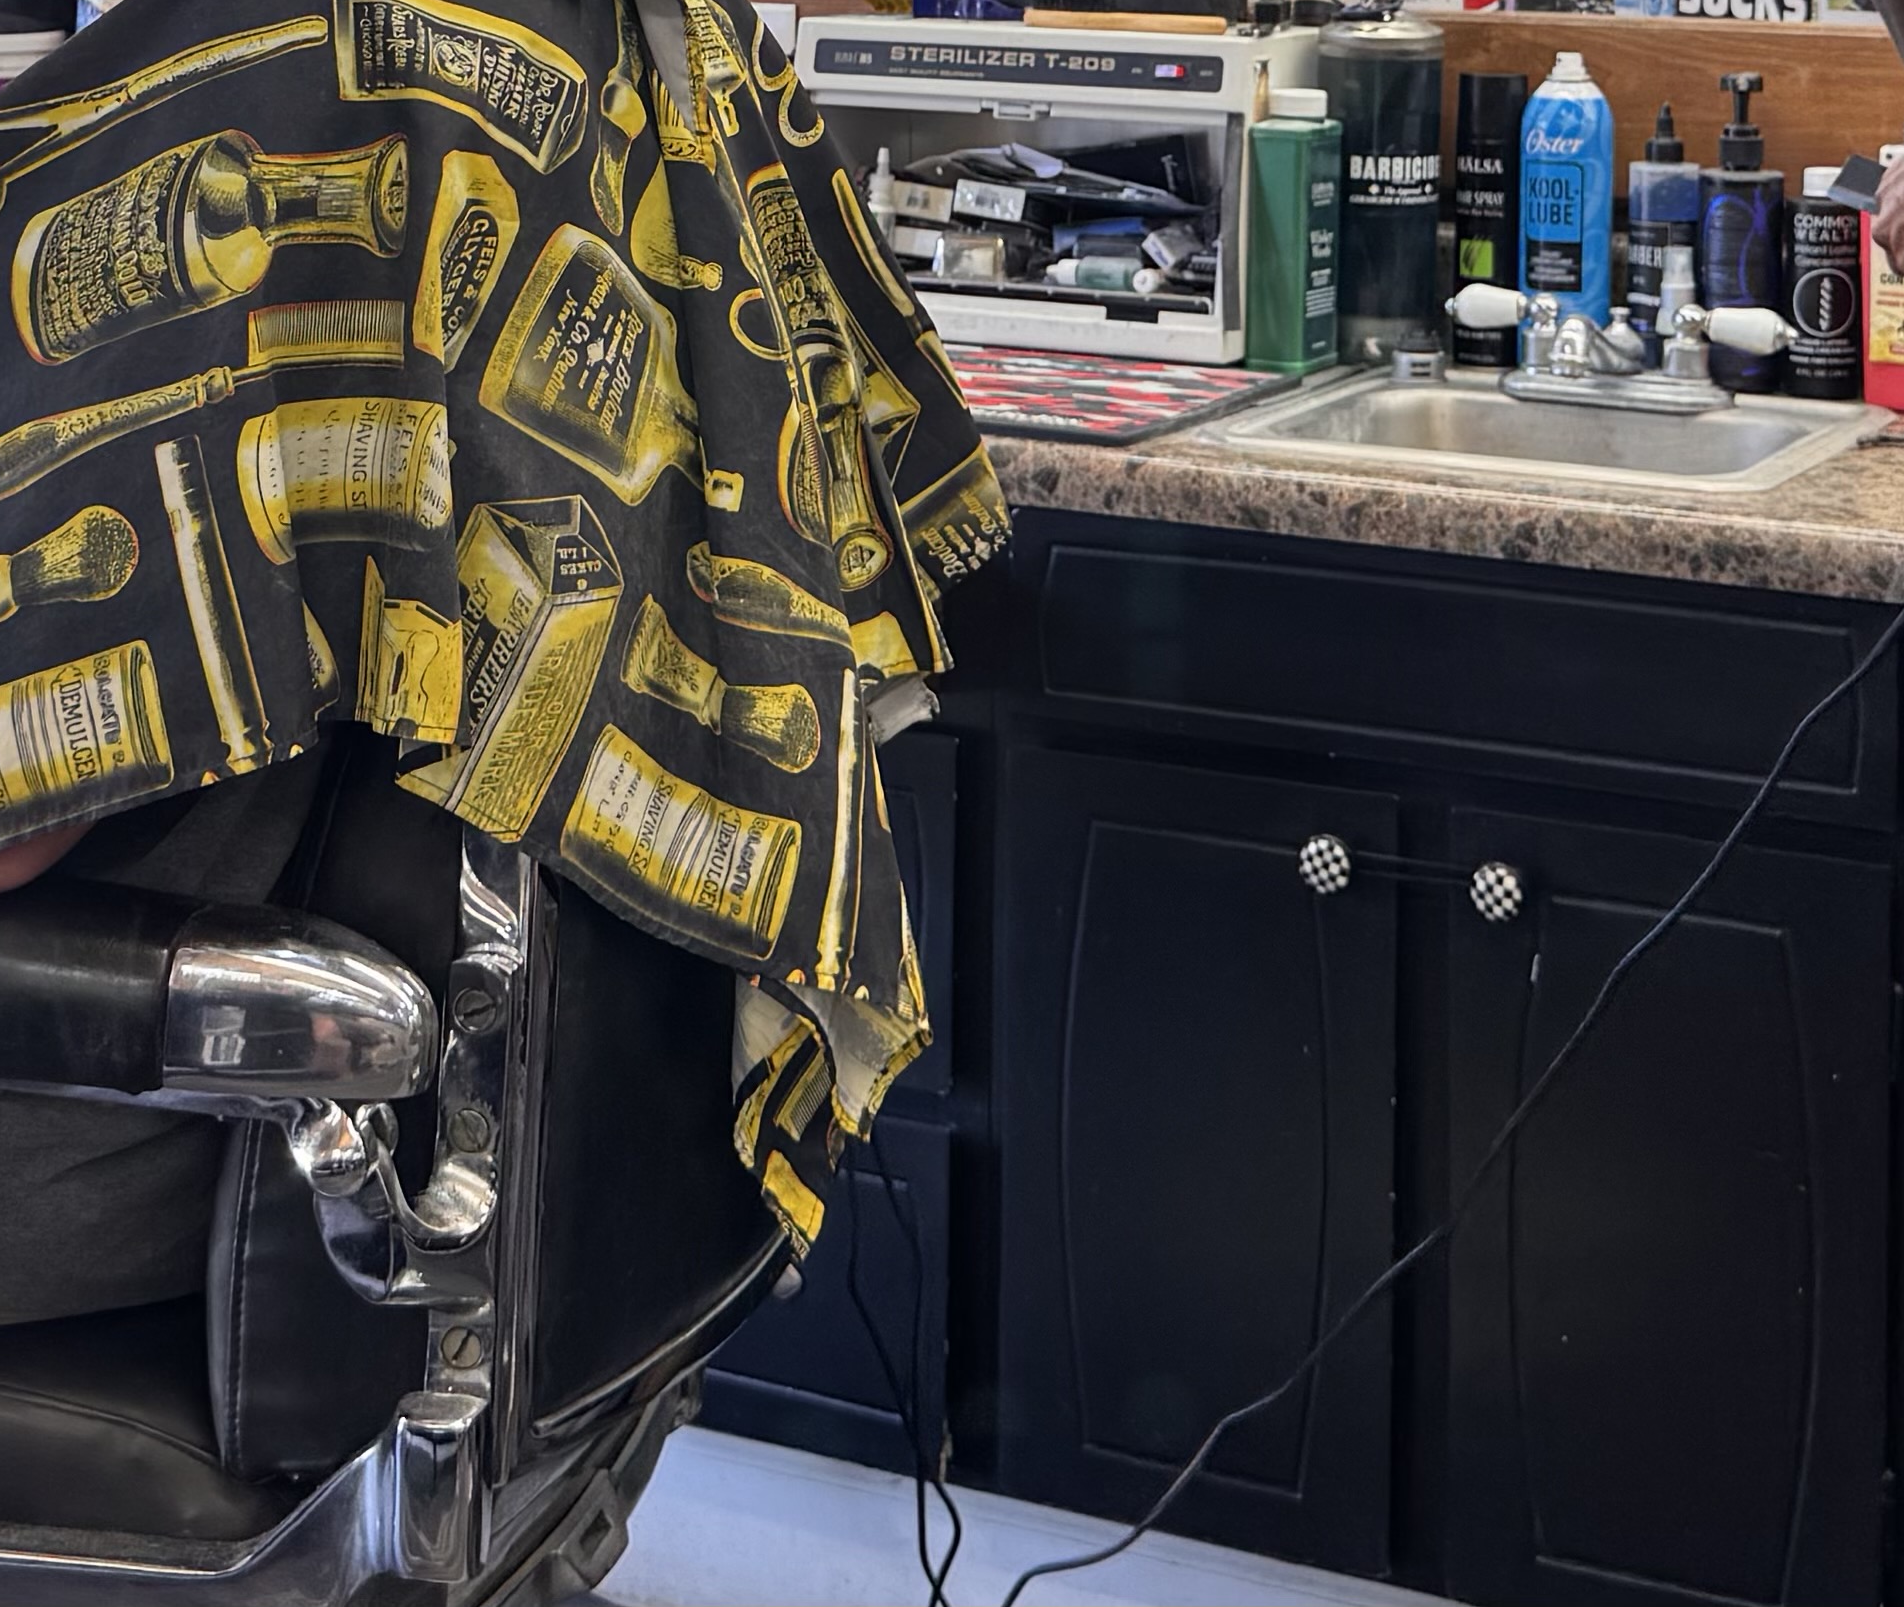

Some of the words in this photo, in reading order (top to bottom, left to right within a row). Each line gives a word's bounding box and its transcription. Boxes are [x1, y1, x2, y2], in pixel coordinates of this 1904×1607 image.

[889, 44, 1036, 68] STERILIZER
[1044, 51, 1117, 73] T-209
[1526, 128, 1585, 155] Oster
[1349, 154, 1441, 181] BARBICIDE
[1473, 190, 1505, 208] SPRAY
[1527, 204, 1575, 226] LUBE
[350, 400, 382, 485] SHAVING
[638, 779, 675, 851] SHAVING
